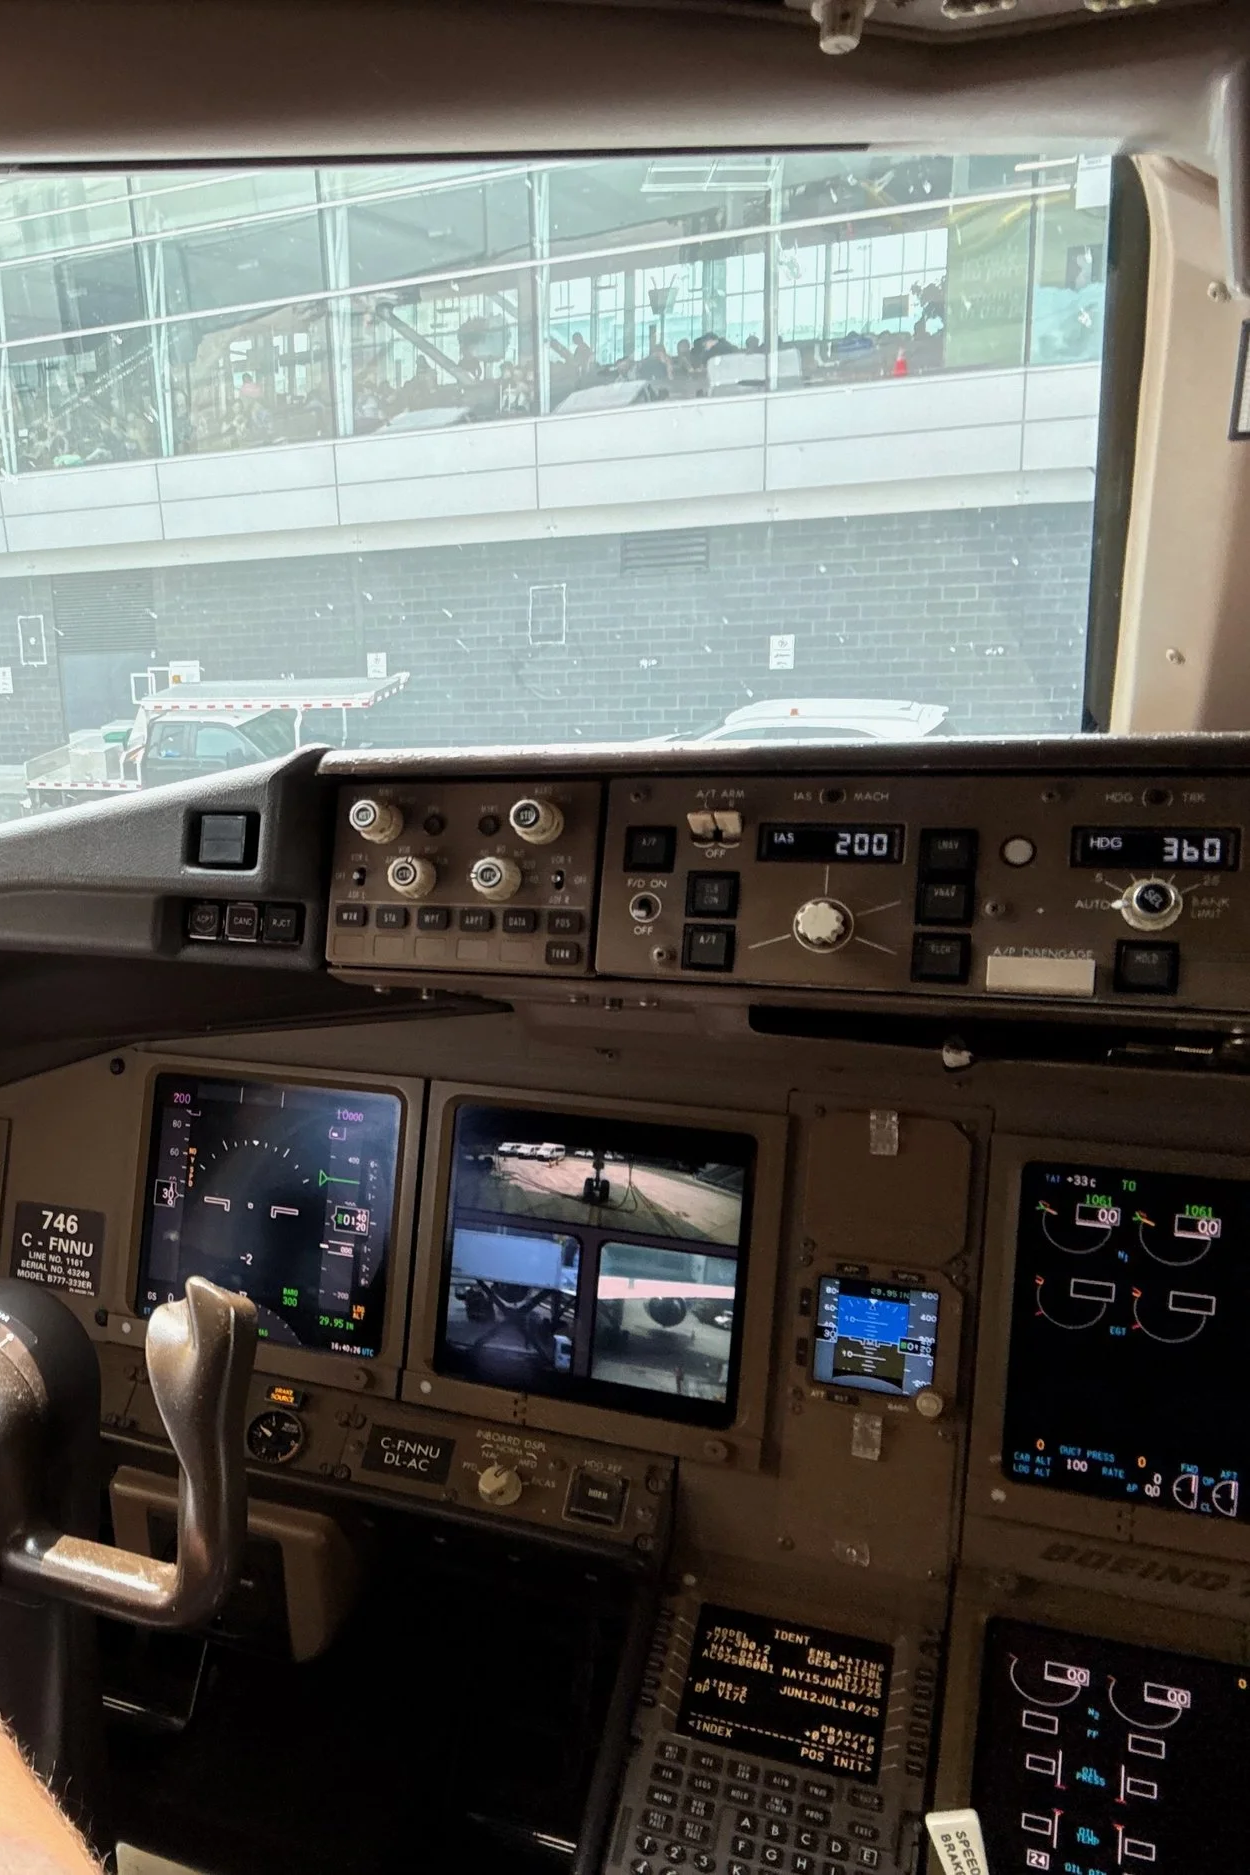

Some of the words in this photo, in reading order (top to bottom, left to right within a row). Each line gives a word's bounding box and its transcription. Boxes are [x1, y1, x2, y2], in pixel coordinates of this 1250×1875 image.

[696, 789, 717, 800] A/T
[720, 789, 745, 801] ARM
[793, 791, 813, 802] IAS
[854, 791, 890, 802] MACH
[1105, 791, 1135, 803] HDG
[773, 832, 795, 845] IAS
[835, 832, 888, 857] 200
[1089, 835, 1123, 851] HDG
[705, 848, 726, 861] OFF
[626, 878, 647, 890] F/D
[650, 878, 668, 890] ON
[1075, 899, 1110, 912] AUTO
[508, 916, 527, 927] DATA
[633, 924, 654, 937] OFF
[1022, 947, 1094, 962] DISENGAGE
[173, 1092, 191, 1104] 200
[336, 1108, 364, 1122] 10000
[172, 1119, 182, 1129] 80
[169, 1147, 180, 1157] 60
[1122, 1179, 1137, 1192] TO
[41, 1209, 79, 1235] 746
[21, 1232, 33, 1247] C
[48, 1236, 94, 1257] FNNU
[28, 1250, 46, 1261] LINE
[48, 1253, 62, 1264] NO.
[65, 1256, 83, 1267] 1161
[240, 1253, 253, 1266] -2
[20, 1259, 48, 1272] SERIAL
[50, 1264, 64, 1274] NO.
[66, 1267, 90, 1279] 43249
[16, 1268, 45, 1281] MODEL
[47, 1273, 92, 1290] B777-333ER
[147, 1290, 157, 1301] GS
[825, 1286, 837, 1294] 80
[870, 1287, 897, 1298] 29.95
[282, 1296, 297, 1307] 300
[823, 1303, 836, 1312] 60
[319, 1315, 344, 1329] 29.95
[920, 1314, 937, 1323] 400
[1109, 1325, 1127, 1337] EGT
[361, 1347, 374, 1358] UTC
[274, 1387, 294, 1396] BRAKE
[476, 1429, 521, 1446] INBOARD
[380, 1437, 441, 1459] C-FNNU
[1036, 1438, 1045, 1451] 0
[1013, 1450, 1030, 1462] CAB
[1034, 1455, 1051, 1466] ALT
[1059, 1444, 1082, 1457] DUCT
[1086, 1449, 1115, 1463] PRESS
[383, 1451, 429, 1472] DL-AC
[1066, 1458, 1088, 1472] 100
[1137, 1455, 1147, 1468] 0
[1180, 1462, 1199, 1474] FWD
[1033, 1467, 1051, 1478] ALT
[1101, 1466, 1125, 1479] RATE
[1153, 1472, 1162, 1485] 0
[1038, 1541, 1231, 1591] BOEING
[714, 1625, 748, 1640] MODEL
[774, 1629, 810, 1646] IDENT
[706, 1631, 771, 1655] 777-300.2
[710, 1643, 732, 1654] NAV
[739, 1650, 768, 1663] DATA
[809, 1647, 831, 1659] ENG
[839, 1654, 885, 1672] RATING
[702, 1648, 774, 1674] AC92506001
[781, 1666, 882, 1699] MAY15JUN12/25
[779, 1685, 880, 1718] JUN12JUL10/25
[820, 1724, 875, 1744] DRAG/FF
[800, 1747, 824, 1762] POS
[1075, 1771, 1106, 1787] PRESS
[740, 1816, 750, 1828] A
[771, 1824, 779, 1836] B
[800, 1833, 810, 1845] C
[737, 1840, 746, 1852] F
[831, 1840, 842, 1853] D
[955, 1830, 981, 1875] SPEED
[765, 1849, 777, 1861] G
[1029, 1852, 1046, 1866] 24
[796, 1857, 807, 1870] H
[1064, 1861, 1083, 1875] OIL
